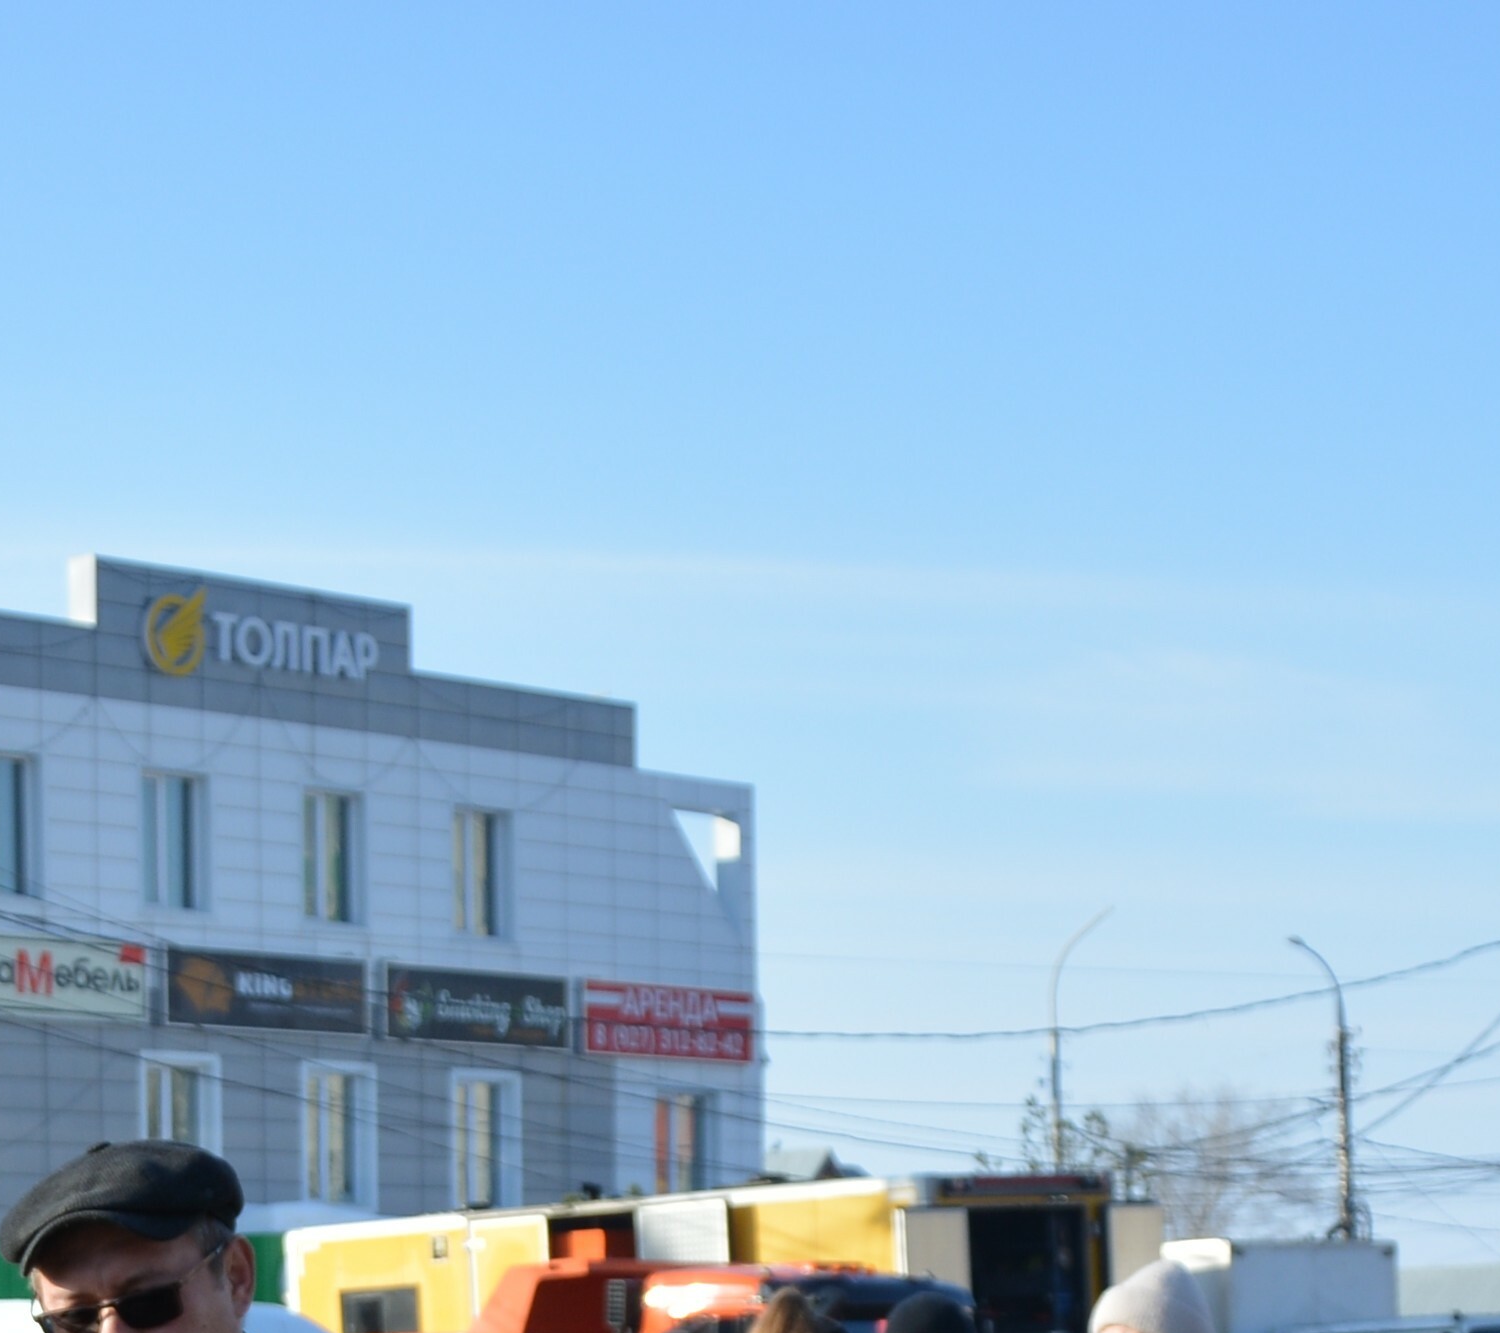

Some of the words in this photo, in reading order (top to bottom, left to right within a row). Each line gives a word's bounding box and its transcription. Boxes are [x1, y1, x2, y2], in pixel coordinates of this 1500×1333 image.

[211, 611, 379, 679] ТОЛПАР
[235, 971, 294, 1001] KING
[622, 986, 719, 1027] АРЕНДА
